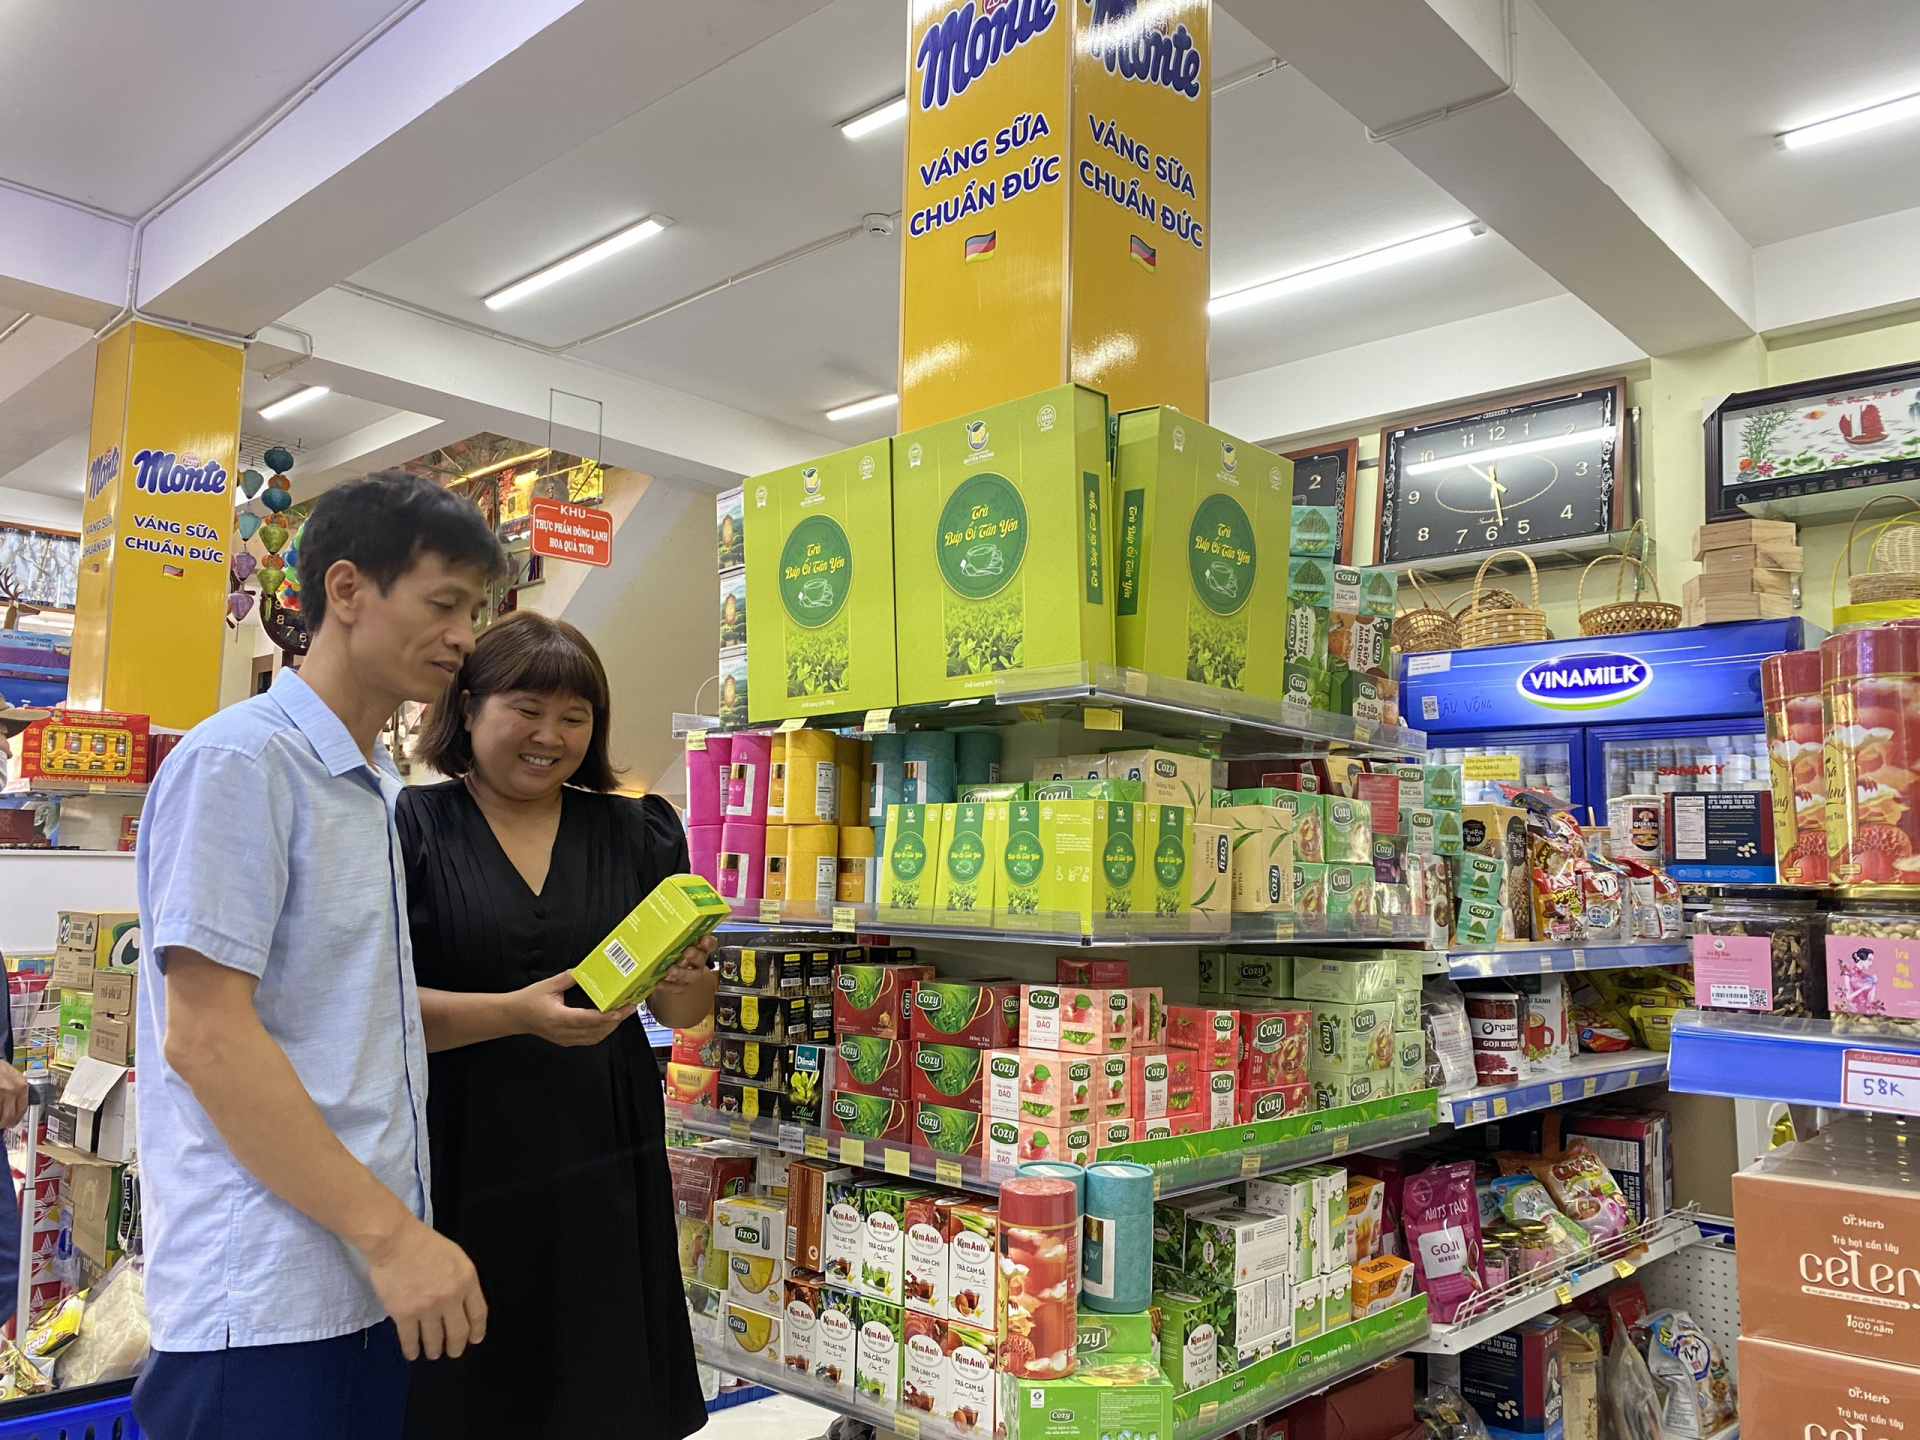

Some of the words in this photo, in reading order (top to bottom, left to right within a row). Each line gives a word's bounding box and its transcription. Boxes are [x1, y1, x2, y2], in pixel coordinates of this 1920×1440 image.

[919, 140, 988, 189] VÁNG
[995, 113, 1049, 158] SỮA
[1088, 114, 1151, 170] VÁNG
[1155, 155, 1196, 200] SỮA
[909, 180, 996, 238] CHUẨN
[1002, 156, 1060, 201] ĐỨC
[1079, 159, 1155, 222] CHUẨN
[1161, 211, 1204, 248] ĐỨC
[1489, 426, 1505, 441] 12
[1524, 423, 1530, 436] 1
[1462, 433, 1475, 448] 11
[89, 446, 119, 499] Monte
[133, 449, 227, 495] Monte
[1575, 462, 1588, 477] 3
[1309, 475, 1322, 490] 2
[1408, 491, 1420, 504] 9
[560, 505, 586, 518] KHU
[970, 505, 989, 521] Trà
[1560, 505, 1573, 520] 4
[133, 515, 181, 534] VÁNG
[185, 524, 219, 541] SỮA
[535, 519, 553, 531] THỰC
[554, 519, 572, 534] PHẨM
[572, 524, 590, 538] ĐÔNG
[590, 529, 608, 542] LẠNH
[944, 530, 963, 546] Búp
[965, 523, 976, 542] Ổi
[978, 523, 997, 538] Tân
[998, 517, 1018, 537] Yên
[1217, 523, 1231, 538] Trà
[1418, 528, 1430, 541] 8
[1486, 526, 1498, 541] 6
[1518, 519, 1530, 535] 5
[1456, 529, 1468, 544] 7
[124, 537, 184, 557] CHUẨN
[189, 547, 224, 563] ĐỨC
[549, 537, 562, 548] HOA
[564, 539, 578, 553] QUẢ
[578, 542, 594, 555] TƯƠI
[806, 543, 821, 557] Trà
[785, 564, 800, 581] Búp
[802, 557, 812, 577] Ổi
[813, 559, 828, 575] Tân
[829, 556, 845, 573] Yên
[1335, 570, 1358, 584] Cozy
[1373, 636, 1381, 661] Cozy
[1291, 678, 1307, 690] Cozy
[1529, 664, 1641, 691] VINAMILK
[1361, 686, 1375, 697] Cozy
[1156, 761, 1176, 776] Cozy
[1399, 770, 1421, 779] Cozy
[1657, 764, 1725, 776] SANAKY
[1302, 780, 1316, 790] Cozy
[1276, 800, 1298, 815] Cozy
[1334, 806, 1351, 819] Cozy
[1413, 815, 1431, 825] Cozy
[1219, 838, 1227, 870] Cozy
[1376, 844, 1393, 855] Cozy
[1474, 860, 1494, 871] Cozy
[1271, 869, 1279, 900] Cozy
[1332, 873, 1351, 887] Cozy
[1470, 906, 1492, 916] Cozy
[839, 977, 856, 988] Cozy
[918, 993, 942, 1007] Cozy
[1030, 991, 1058, 1008] Cozy
[1260, 1024, 1283, 1037] Cozy
[841, 1045, 858, 1057] Cozy
[797, 1056, 816, 1067] Dilmah
[918, 1054, 941, 1068] Cozy
[991, 1060, 1018, 1077] Cozy
[1863, 1078, 1904, 1097] 58K
[795, 1106, 814, 1118] Mint
[835, 1101, 856, 1116] Cozy
[1259, 1098, 1282, 1113] Cozy
[919, 1114, 940, 1129] Cozy
[991, 1126, 1017, 1143] Cozy
[1180, 1155, 1190, 1164] Trà
[1349, 1192, 1369, 1207] Blendy
[1425, 1202, 1446, 1222] NUTS
[1448, 1197, 1470, 1215] TALK
[868, 1241, 876, 1249] TRÀ
[1430, 1241, 1461, 1257] GOJI
[1832, 1235, 1846, 1245] Trà
[1848, 1237, 1862, 1248] hạt
[1865, 1240, 1881, 1251] cần
[1884, 1243, 1899, 1255] tây
[911, 1254, 919, 1262] TRÀ
[920, 1256, 930, 1264] LINH
[931, 1259, 940, 1267] CHI
[1438, 1253, 1460, 1264] BERRIES
[956, 1263, 966, 1271] TRÀ
[966, 1265, 976, 1275] CAM
[1378, 1272, 1399, 1294] Blendy
[1873, 1322, 1893, 1335] năm
[1837, 1406, 1851, 1418] Trà
[1853, 1409, 1869, 1422] hạt
[1871, 1412, 1887, 1425] cần
[1888, 1415, 1904, 1430] tây
